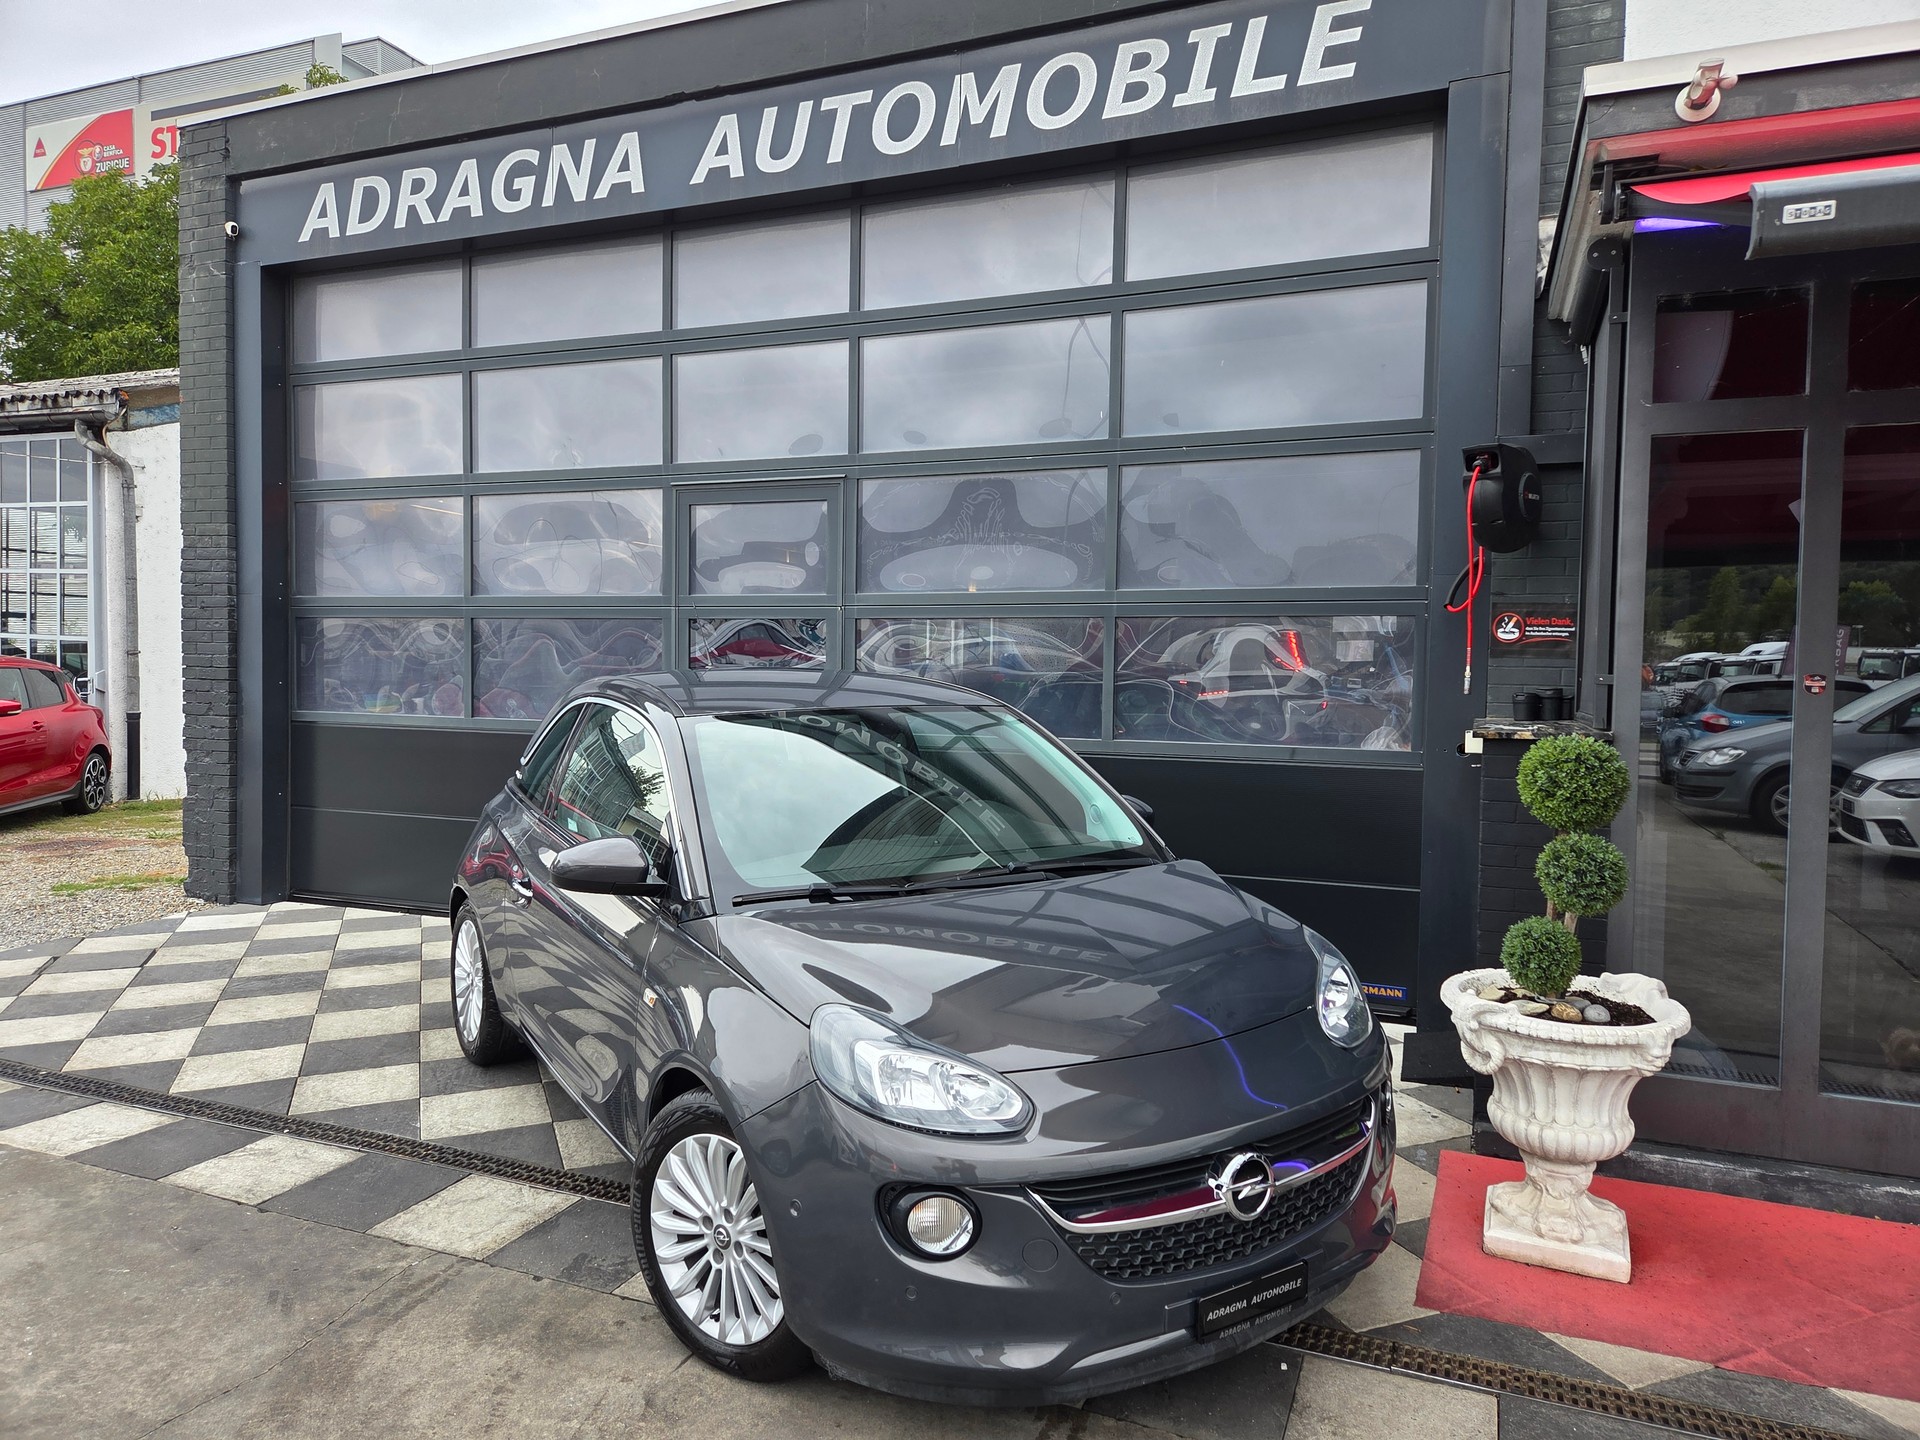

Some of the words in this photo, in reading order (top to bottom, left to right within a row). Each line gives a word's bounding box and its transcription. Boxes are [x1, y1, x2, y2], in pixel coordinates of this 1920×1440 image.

[298, 131, 645, 242] ADRAGNA
[690, 0, 1372, 185] AUTOMOBILE
[1526, 617, 1549, 625] Vielen
[1206, 1299, 1247, 1322] ADRAGNA
[1250, 1278, 1303, 1306] AUTOMOBILE
